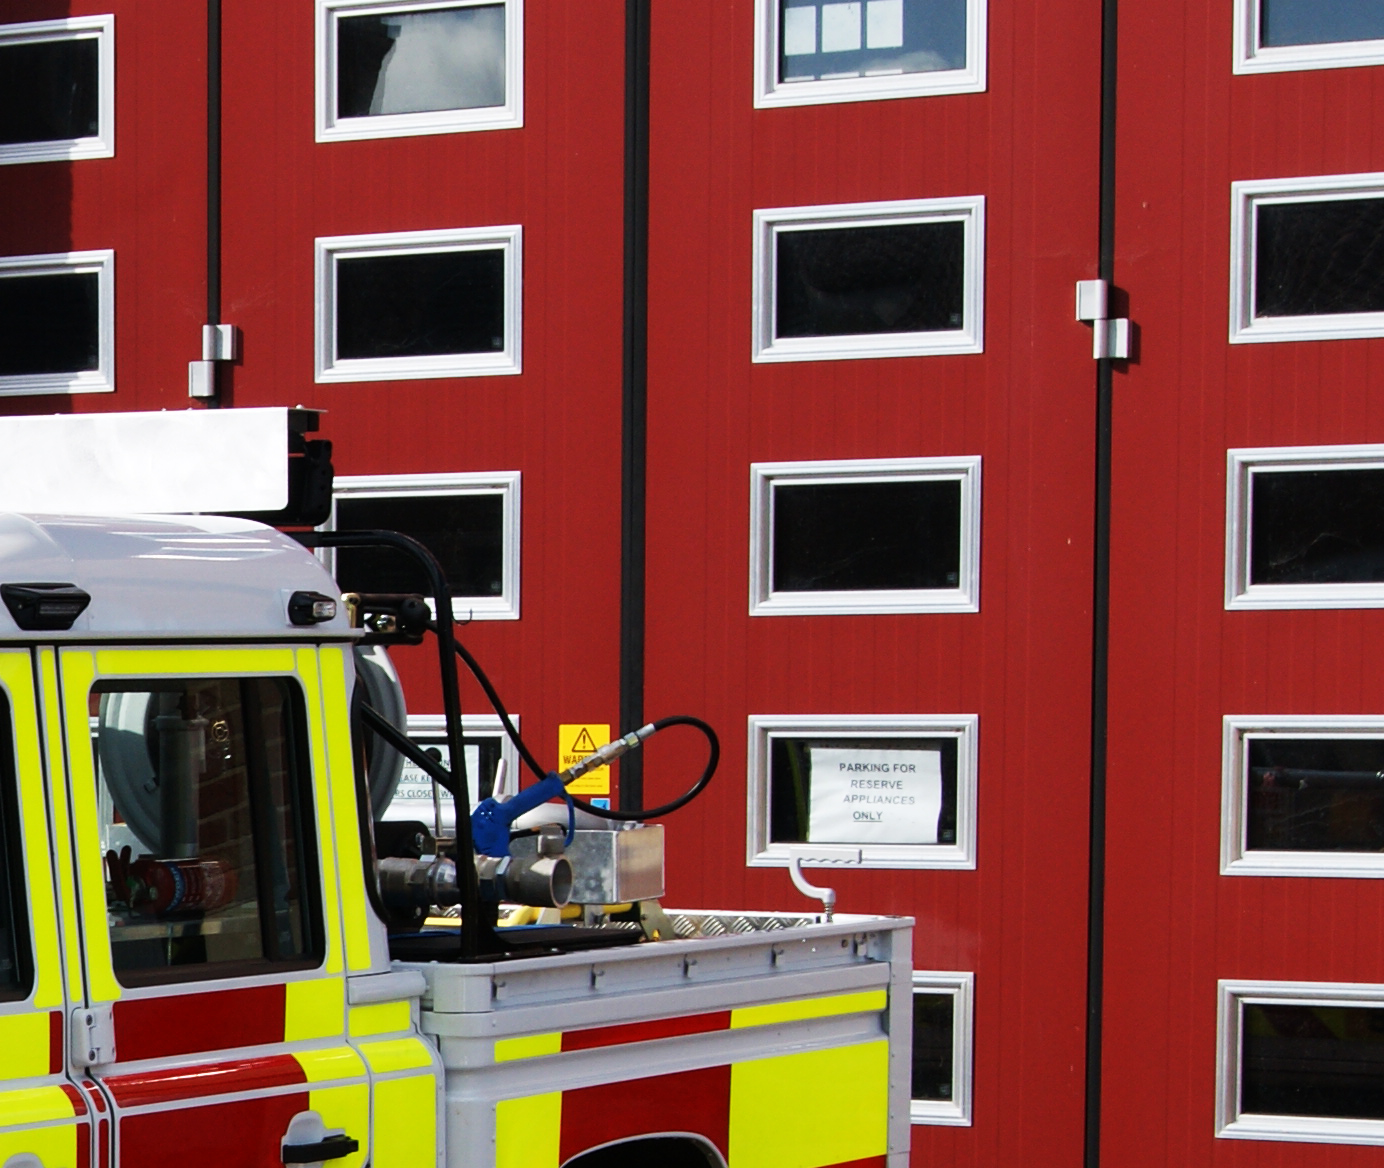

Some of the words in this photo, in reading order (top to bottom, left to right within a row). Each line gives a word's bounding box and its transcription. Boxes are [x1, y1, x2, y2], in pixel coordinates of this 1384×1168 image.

[839, 762, 890, 773] PARKING
[893, 763, 916, 773] FOR
[850, 779, 903, 790] RESERVE
[843, 794, 915, 805] APPLIANCES
[853, 810, 883, 820] ONLY
